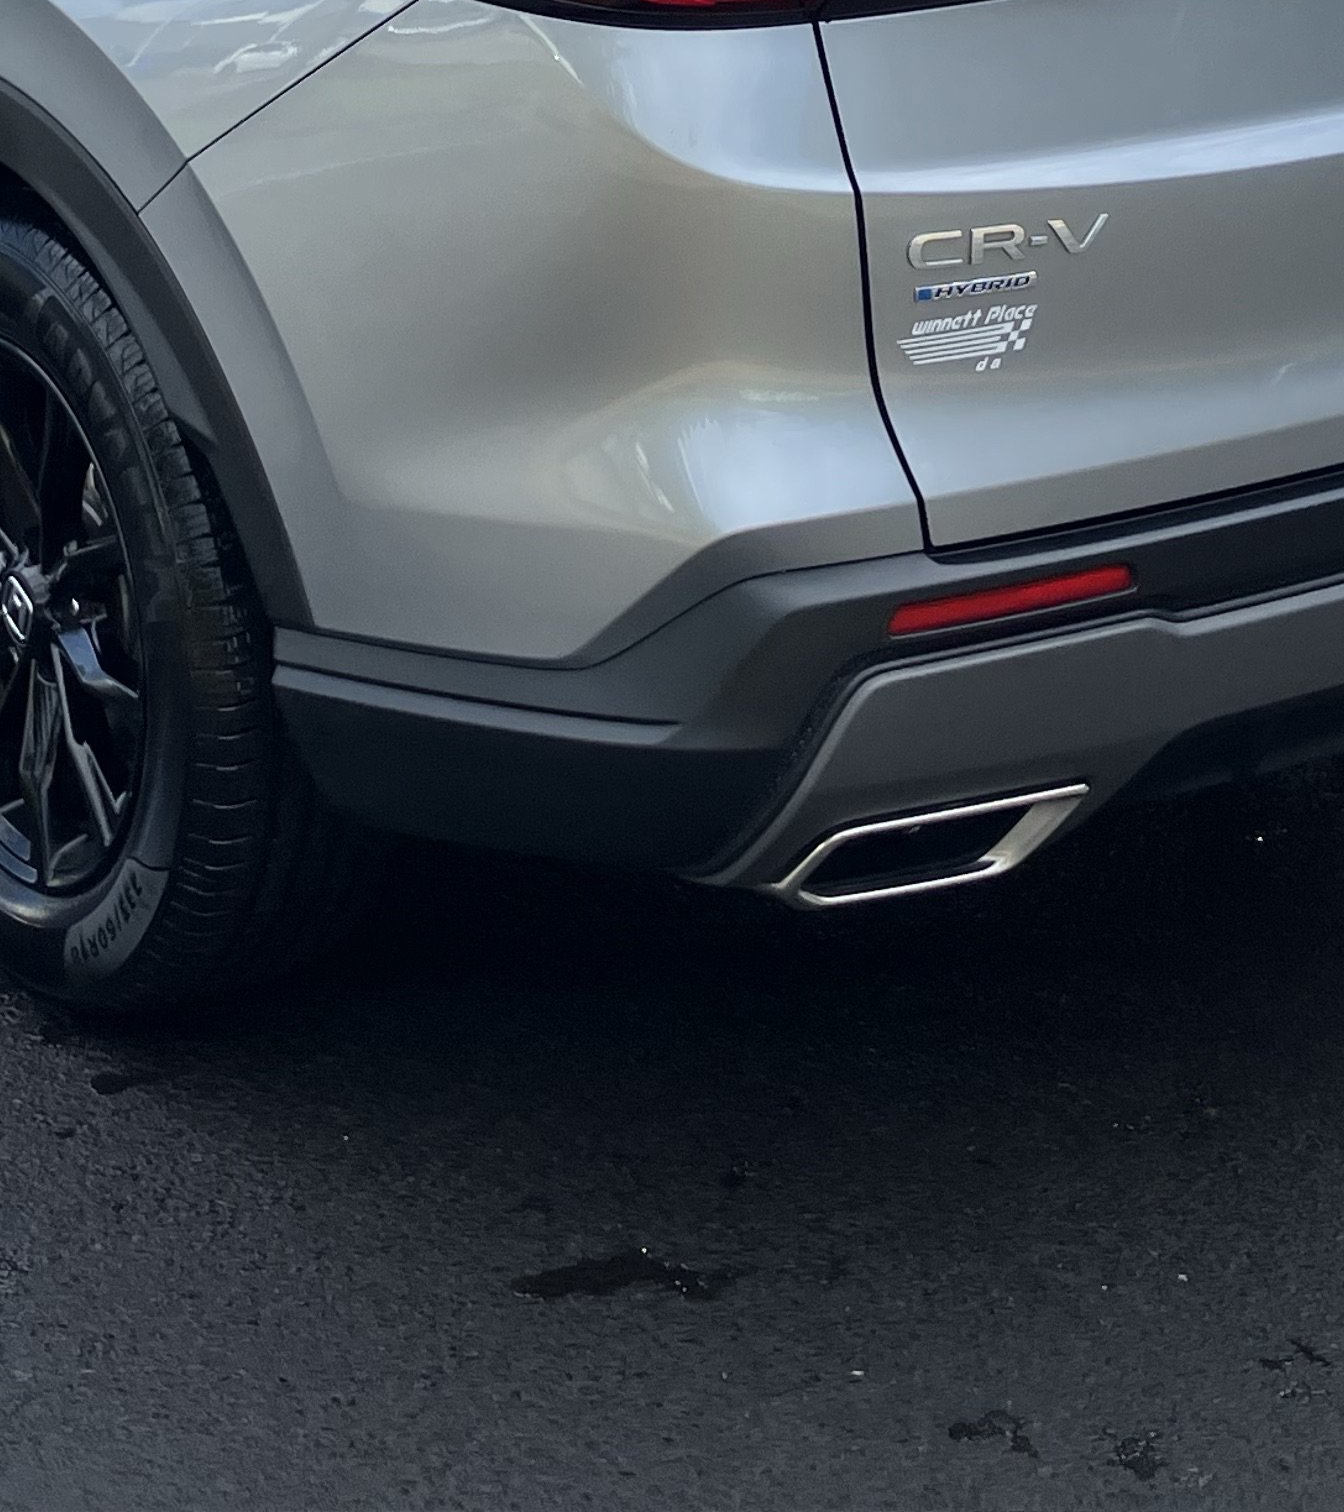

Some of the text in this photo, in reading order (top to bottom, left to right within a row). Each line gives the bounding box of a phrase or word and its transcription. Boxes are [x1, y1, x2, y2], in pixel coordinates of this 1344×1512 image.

[907, 213, 1109, 270] CR-V
[935, 275, 1031, 299] HYBRID
[984, 304, 1039, 325] Place
